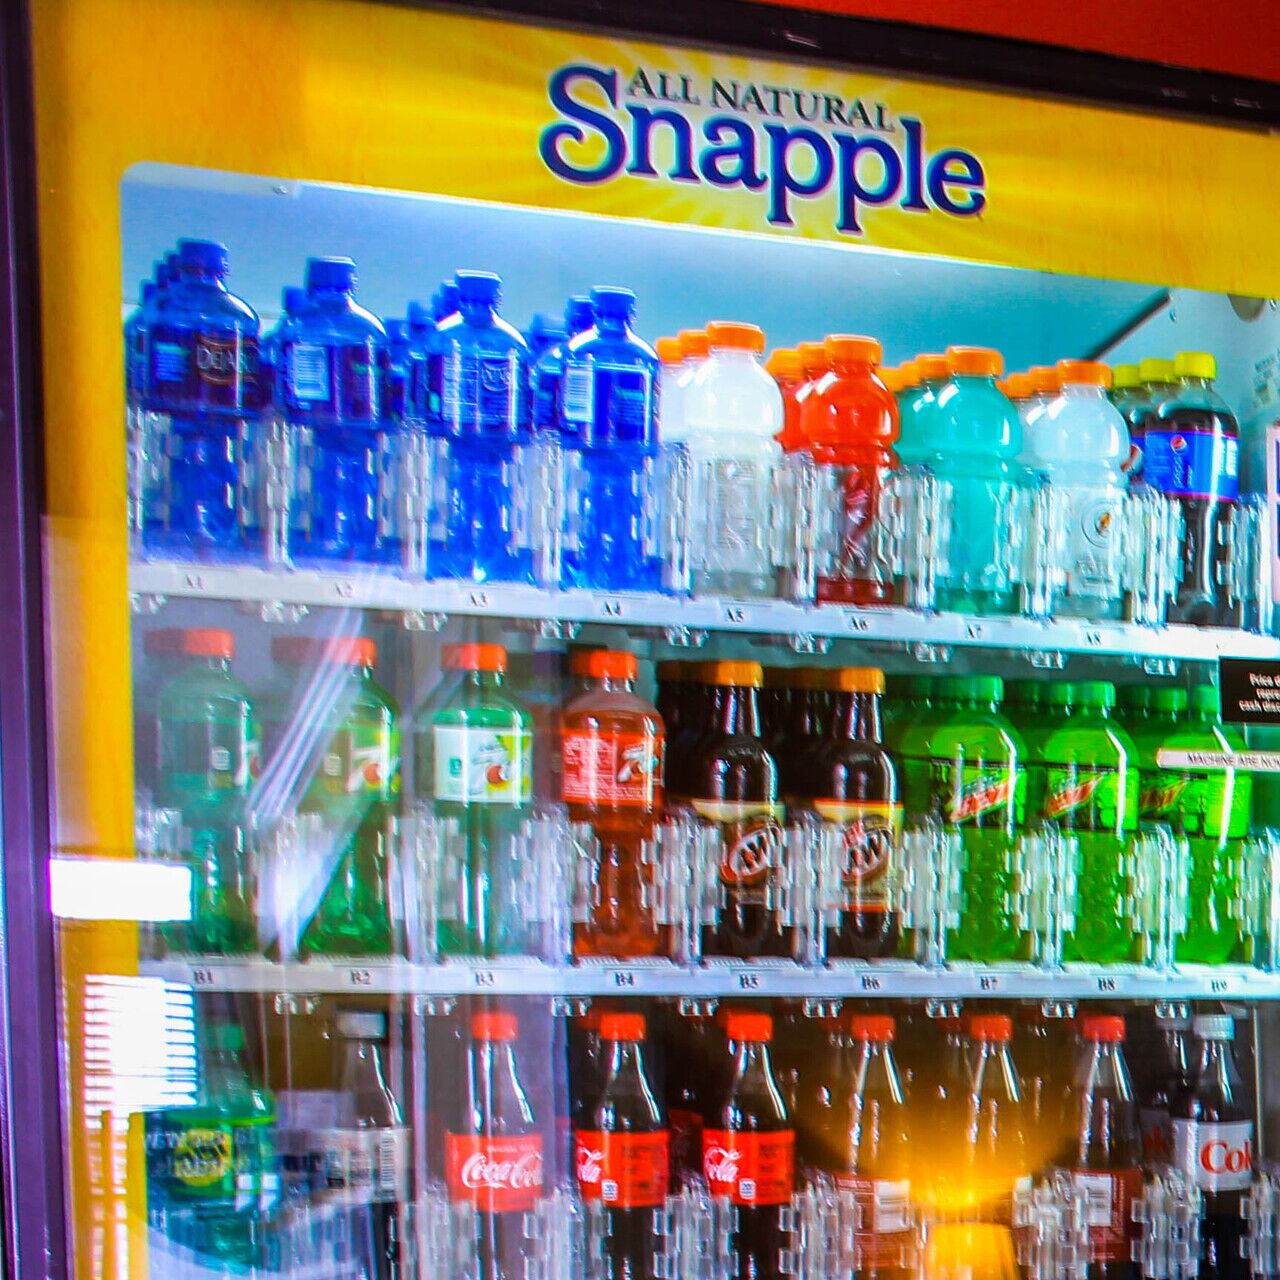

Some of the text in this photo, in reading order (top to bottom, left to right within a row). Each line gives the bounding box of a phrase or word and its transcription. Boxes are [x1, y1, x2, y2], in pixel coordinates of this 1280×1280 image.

[626, 66, 895, 132] ALL NATURAL
[539, 63, 986, 235] Snapple
[724, 607, 744, 623] A5
[849, 615, 870, 631] A6
[1249, 672, 1274, 687] Price
[1239, 699, 1262, 713] cash
[1186, 752, 1235, 768] MACHINE
[1239, 756, 1260, 768] ARE
[614, 971, 634, 987] B4
[739, 975, 759, 990] B5
[861, 976, 881, 990] B6
[980, 976, 999, 990] B7
[1097, 977, 1116, 992] B8
